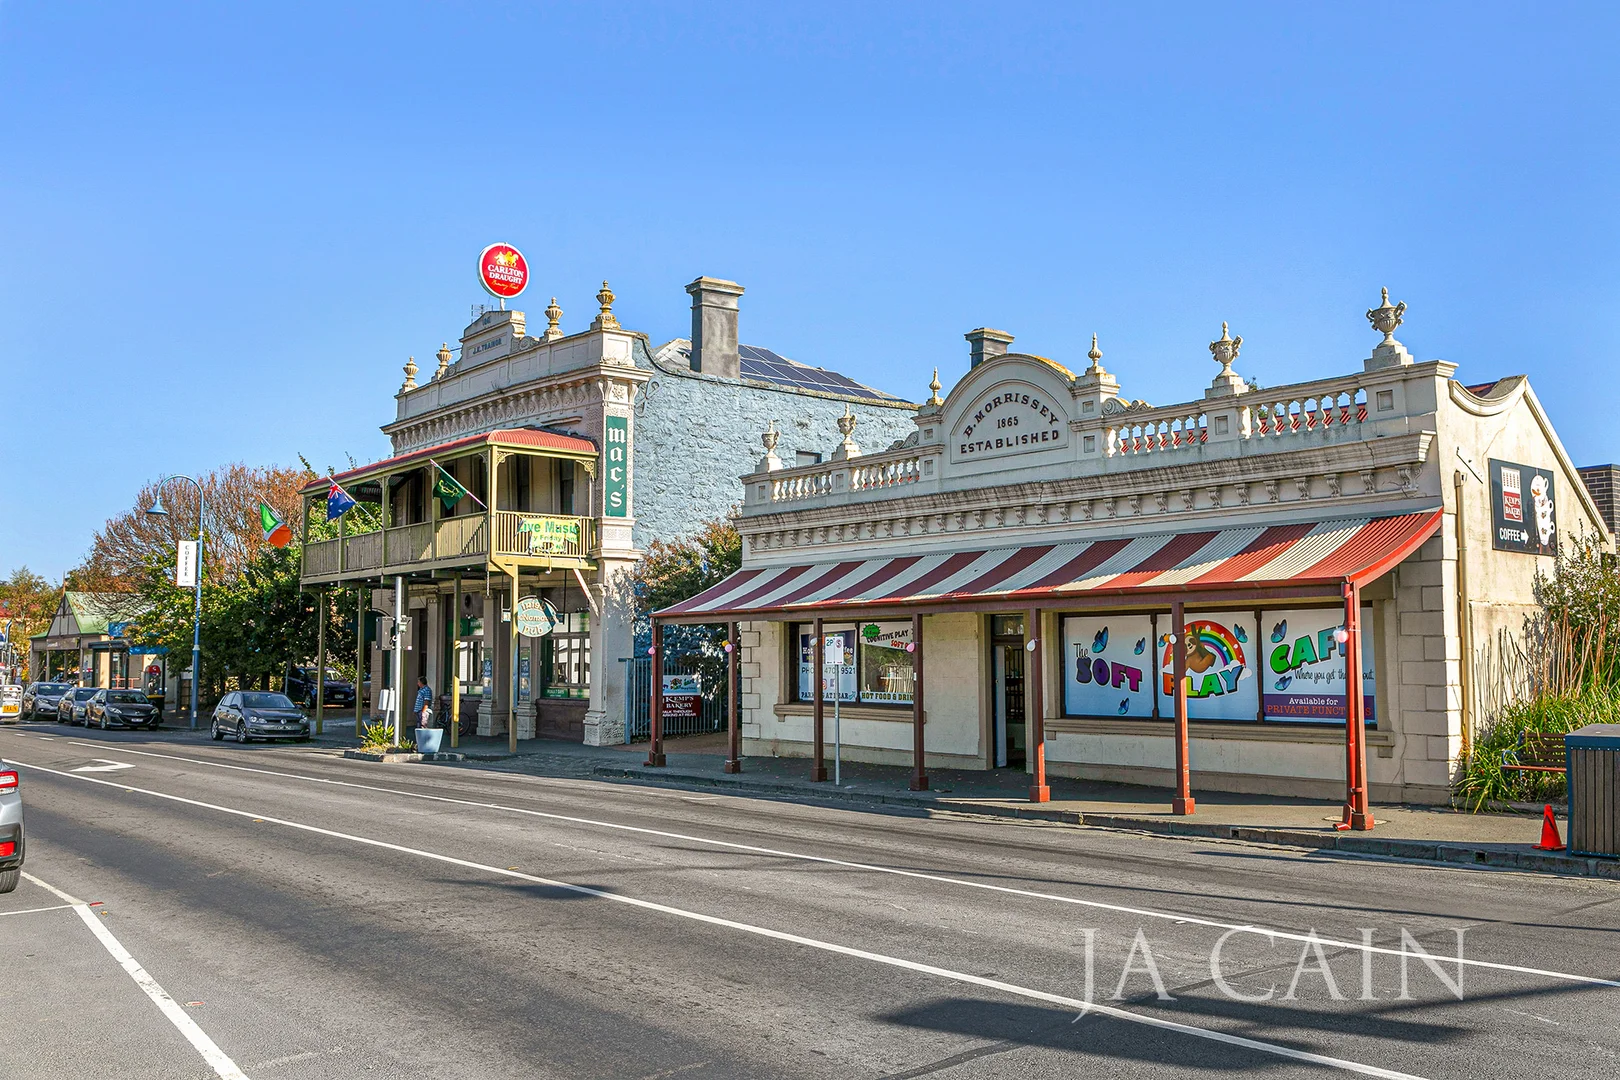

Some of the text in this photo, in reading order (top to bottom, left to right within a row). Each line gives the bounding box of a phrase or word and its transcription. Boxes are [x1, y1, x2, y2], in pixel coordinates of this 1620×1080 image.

[487, 264, 524, 278] CARLTON
[489, 272, 523, 284] DRAUGHT
[997, 416, 1019, 429] 1865
[960, 430, 1059, 454] ESTABLISHED
[1499, 528, 1521, 541] COFFEE
[867, 629, 909, 643] COGNITIVE PLAY
[890, 639, 904, 649] SOFT
[1073, 643, 1088, 657] The
[1076, 656, 1142, 692] SOFT
[1313, 672, 1325, 684] you
[1326, 670, 1336, 684] get
[1163, 665, 1244, 698] PLAY
[898, 693, 914, 701] DRIN
[1289, 697, 1325, 705] Available
[1267, 705, 1373, 716] PRIVATE FUNCTS
